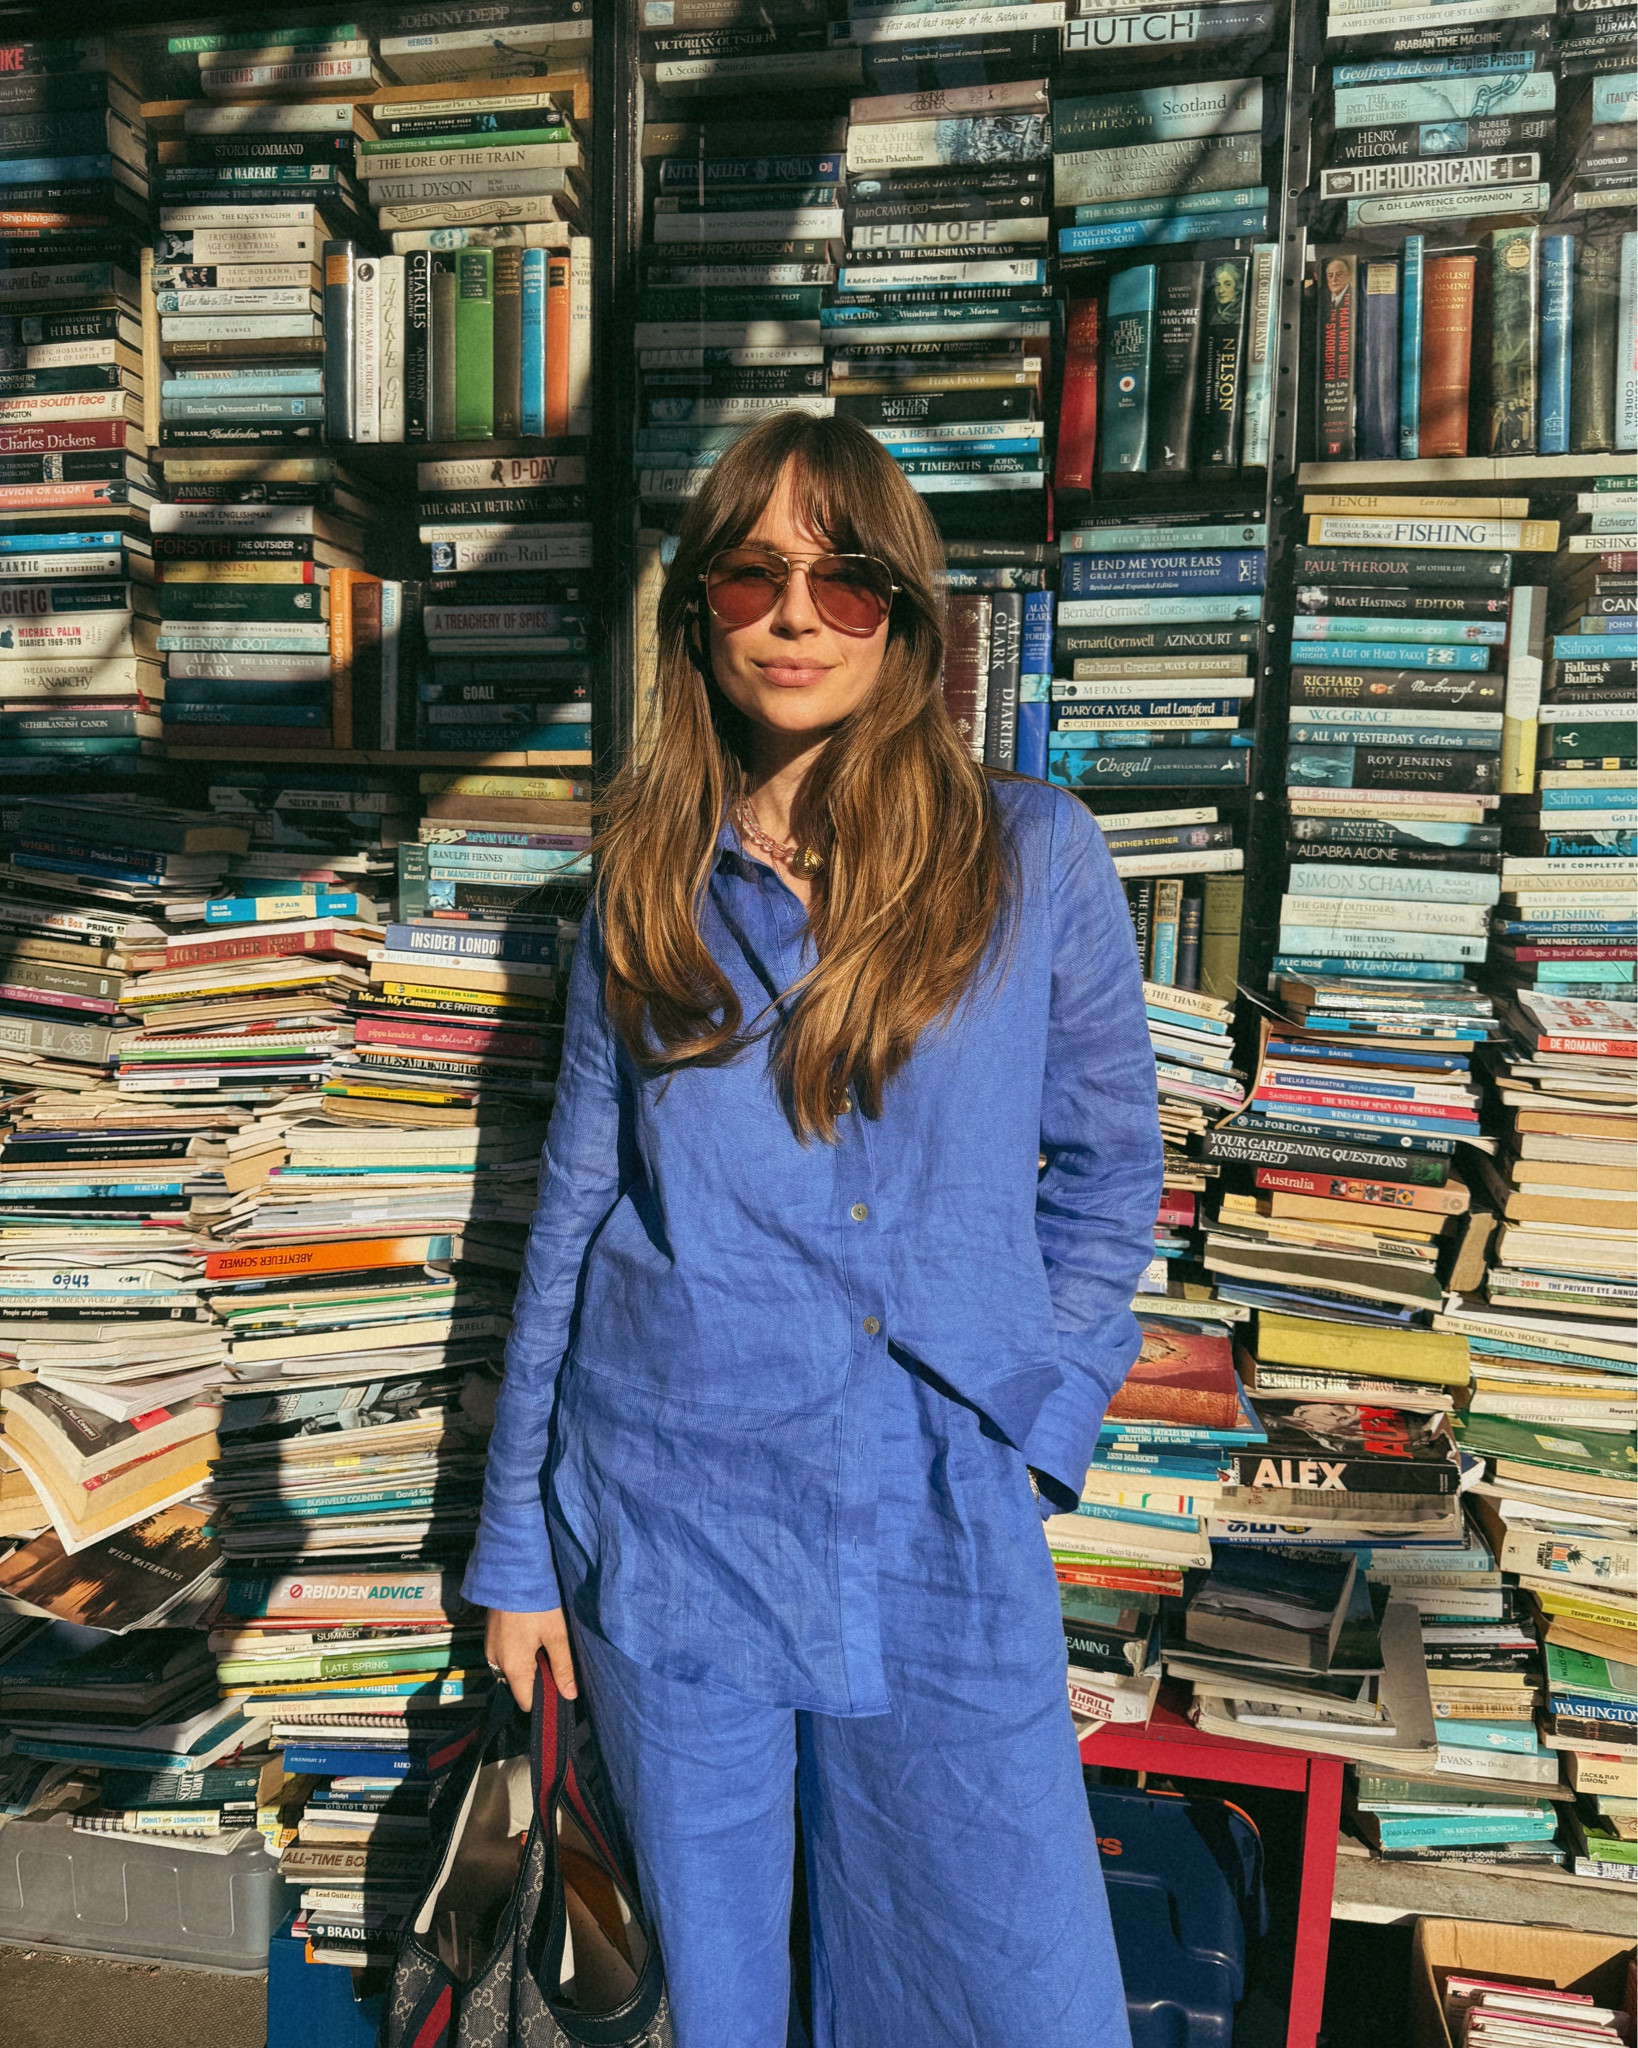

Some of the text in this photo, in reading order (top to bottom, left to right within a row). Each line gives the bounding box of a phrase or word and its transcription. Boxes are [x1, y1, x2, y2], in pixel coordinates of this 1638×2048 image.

[398, 7, 509, 29] JOHNNY DEPP
[886, 19, 902, 32] first
[905, 19, 920, 29] and
[923, 16, 938, 28] last
[941, 16, 967, 29] voyage
[969, 12, 978, 25] of
[981, 13, 992, 22] the
[997, 10, 1028, 22] Batavia
[1066, 12, 1194, 47] HUTCH
[1421, 26, 1474, 37] Helga Graham
[655, 38, 714, 50] VICTORIAN
[1395, 32, 1501, 50] ARABIAN TIME MACHINE
[1340, 65, 1394, 81] Geoffrey
[1395, 62, 1443, 76] Jackson
[1491, 51, 1524, 67] Prison
[1162, 94, 1227, 115] Scotland
[215, 144, 304, 156] STORM COMMAND
[1346, 131, 1408, 158] HENRY WELLCOME
[378, 151, 526, 170] THE LORE OF THE TRAIN
[855, 155, 924, 164] Thomas Pakenham
[217, 168, 232, 179] AIR
[235, 167, 278, 179] WARFARE
[379, 180, 473, 198] WILL DYSON
[1405, 193, 1513, 209] LAWRENCE COMPANION
[221, 212, 238, 220] THE
[261, 211, 291, 219] ENGLISH
[869, 221, 997, 244] FLINTOFF
[1073, 225, 1137, 237] TOUCHING MY
[207, 242, 225, 250] AGE
[238, 241, 279, 249] EXTREMES
[1073, 234, 1135, 246] FATHER'S SOUL
[412, 255, 426, 329] CHARLES
[1324, 323, 1336, 381] SWORDFISH
[1338, 350, 1349, 379] BUILT
[1219, 337, 1235, 412] NELSON
[187, 404, 282, 415] Breeding Ornamental Plants
[882, 406, 928, 416] MOTHER
[1, 435, 96, 451] Charles Dickens
[920, 461, 981, 471] TIMEPATHS
[1329, 496, 1378, 508] TENCH
[1394, 522, 1486, 544] FISHING
[237, 540, 294, 550] THE OUTSIDER
[1091, 556, 1221, 570] LEND ME YOUR EARS
[1304, 560, 1409, 573] PAUL THEROUX
[1415, 598, 1465, 610] EDITOR
[18, 627, 81, 638] MICHAEL PALIN
[19, 637, 82, 647] DIARIES 1969-1979
[183, 638, 270, 650] HENRY ROOT
[994, 612, 1006, 671] CLARK
[1067, 634, 1232, 650] Bernard Cornwell AZINCOURT
[37, 674, 93, 689] ANARCHY
[1303, 676, 1363, 687] RICHARD
[463, 685, 495, 699] GOAL!
[1083, 686, 1133, 695] MEDALS
[1304, 686, 1360, 698] HOLMES
[1150, 702, 1215, 718] Lord Longford
[20, 720, 108, 729] NETHERLANDISH CANON
[999, 688, 1015, 759] DIARIES
[1312, 731, 1463, 746] ALL MY YESTERDAYS Cecil Lewis
[1096, 757, 1151, 774] Chagall
[1367, 755, 1453, 767] ROY JENKINS
[1331, 827, 1396, 839] PINSENT
[1144, 836, 1179, 846] STEINER
[1297, 844, 1398, 861] ALDABRA ALONE
[1296, 871, 1434, 894] SIMON SCHAMA
[273, 901, 301, 909] SPAIN
[45, 913, 83, 928] Black Box
[86, 923, 114, 933] PRING
[1552, 923, 1608, 933] FISHERMAN
[411, 931, 504, 955] INSIDER LONDON
[437, 1002, 498, 1016] JOE PARTRIDGE
[1550, 1038, 1607, 1053] DE ROMANIS
[1328, 1050, 1353, 1058] BAKING
[1264, 1121, 1321, 1134] FORECAST
[1209, 1147, 1288, 1164] ANSWERED
[1210, 1132, 1407, 1168] YOUR GARDENING QUESTIONS
[1262, 1172, 1314, 1190] Australia
[219, 1253, 313, 1269] ABENTEUER SCHWEIZ
[1520, 1280, 1540, 1289] 2019
[1564, 1284, 1609, 1295] PRIVATE EYE
[1252, 1459, 1348, 1491] ALEX
[307, 1493, 384, 1507] BUSHVELD COUNTRY
[1077, 1505, 1119, 1519] WHEN?
[132, 1558, 183, 1581] WATERWAYS
[368, 1586, 424, 1599] ADVICE
[1571, 1610, 1625, 1625] TEHIDY AND THE
[317, 1631, 359, 1641] SUMMER
[326, 1661, 388, 1673] LATE SPRING
[1070, 1686, 1113, 1713] THRILL
[1440, 1754, 1473, 1766] EVANS
[282, 1854, 343, 1866] ALL-TIME
[327, 1927, 380, 1939] BRADLEY
